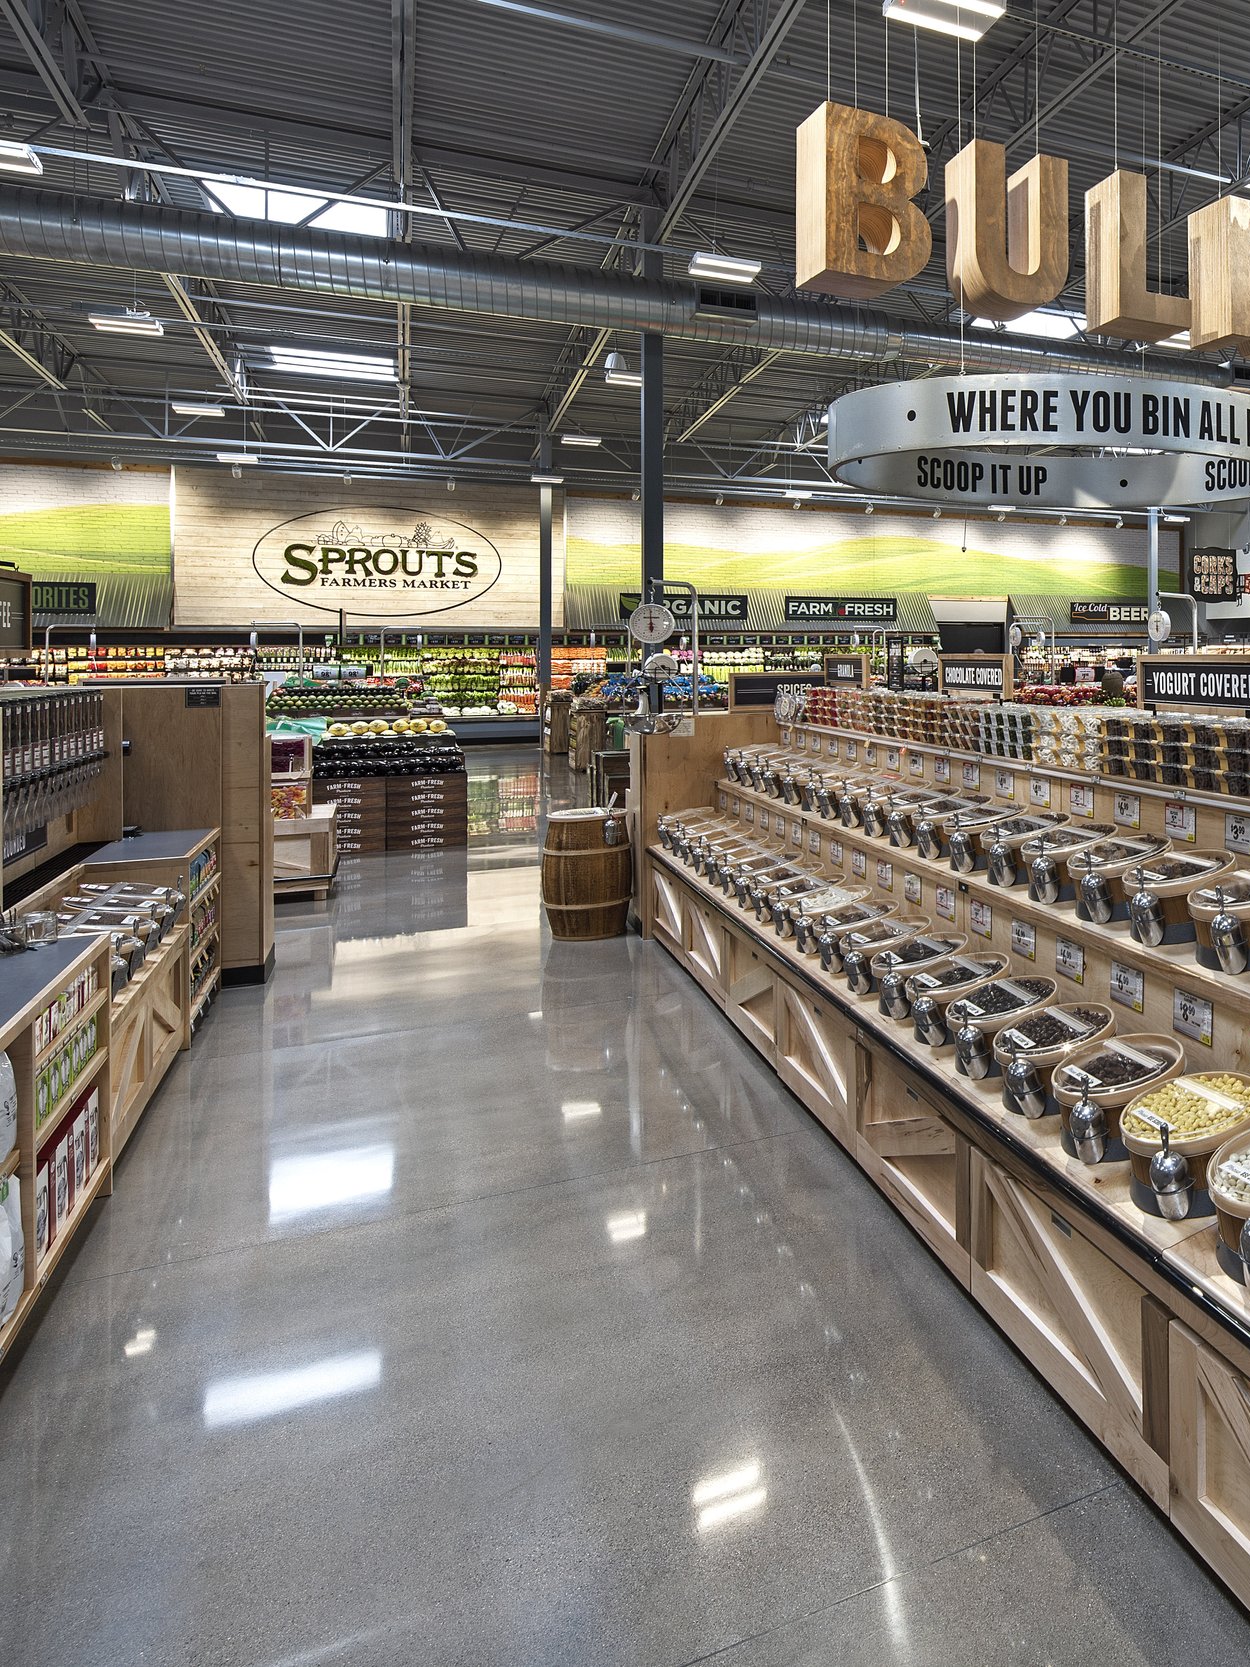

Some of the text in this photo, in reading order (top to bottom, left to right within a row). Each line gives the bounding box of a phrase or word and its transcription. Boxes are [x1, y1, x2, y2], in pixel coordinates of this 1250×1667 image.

[947, 390, 1059, 432] WHERE
[1069, 390, 1131, 434] YOU
[1143, 393, 1190, 438] BIN
[1199, 400, 1240, 445] ALL
[917, 456, 1047, 496] SCOOP IT UP
[281, 543, 478, 586] SPROUTS
[1193, 555, 1233, 575] CORKS
[320, 577, 471, 590] FARMERS MARKET
[788, 602, 894, 616] FARM FRESH
[1074, 603, 1108, 612] Ice Cold
[1110, 608, 1148, 620] BEER
[945, 667, 1002, 686] CHOCOLATE COVERED
[1153, 672, 1196, 697] YOGURT
